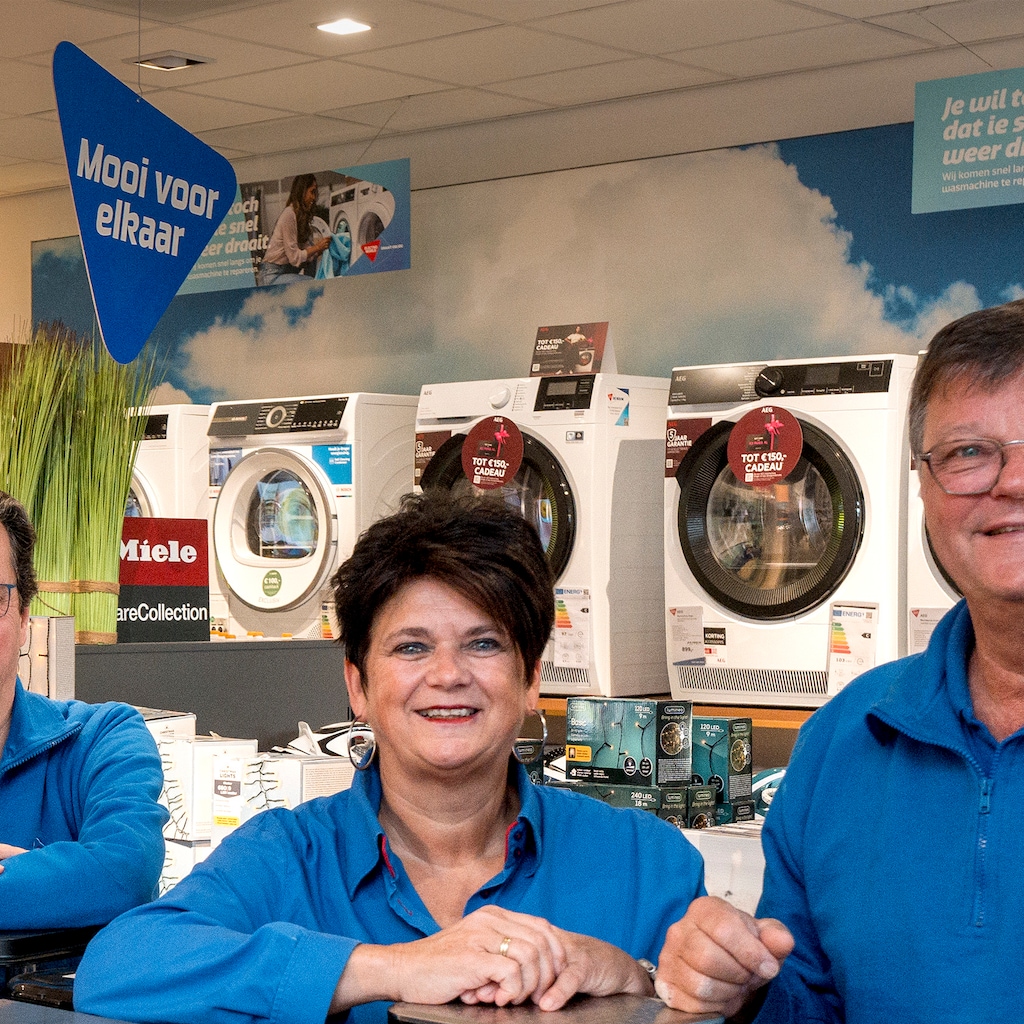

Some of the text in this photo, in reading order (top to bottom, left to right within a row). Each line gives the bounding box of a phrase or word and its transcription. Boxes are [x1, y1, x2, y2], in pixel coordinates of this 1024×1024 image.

[941, 97, 965, 121] Je
[969, 88, 1008, 113] wil
[942, 119, 983, 140] dat
[942, 144, 1002, 165] weer
[76, 137, 219, 220] Mooi voor
[942, 171, 956, 182] Wij
[958, 168, 990, 180] komen
[992, 165, 1010, 176] snel
[941, 180, 999, 193] wasmachine
[1001, 178, 1010, 187] te
[95, 199, 185, 257] elkaar
[229, 215, 259, 234] snel
[472, 457, 487, 467] TOT
[741, 453, 759, 463] TOT
[745, 462, 783, 473] CADEAU
[474, 467, 506, 478] CADEAU
[119, 538, 197, 563] Miele
